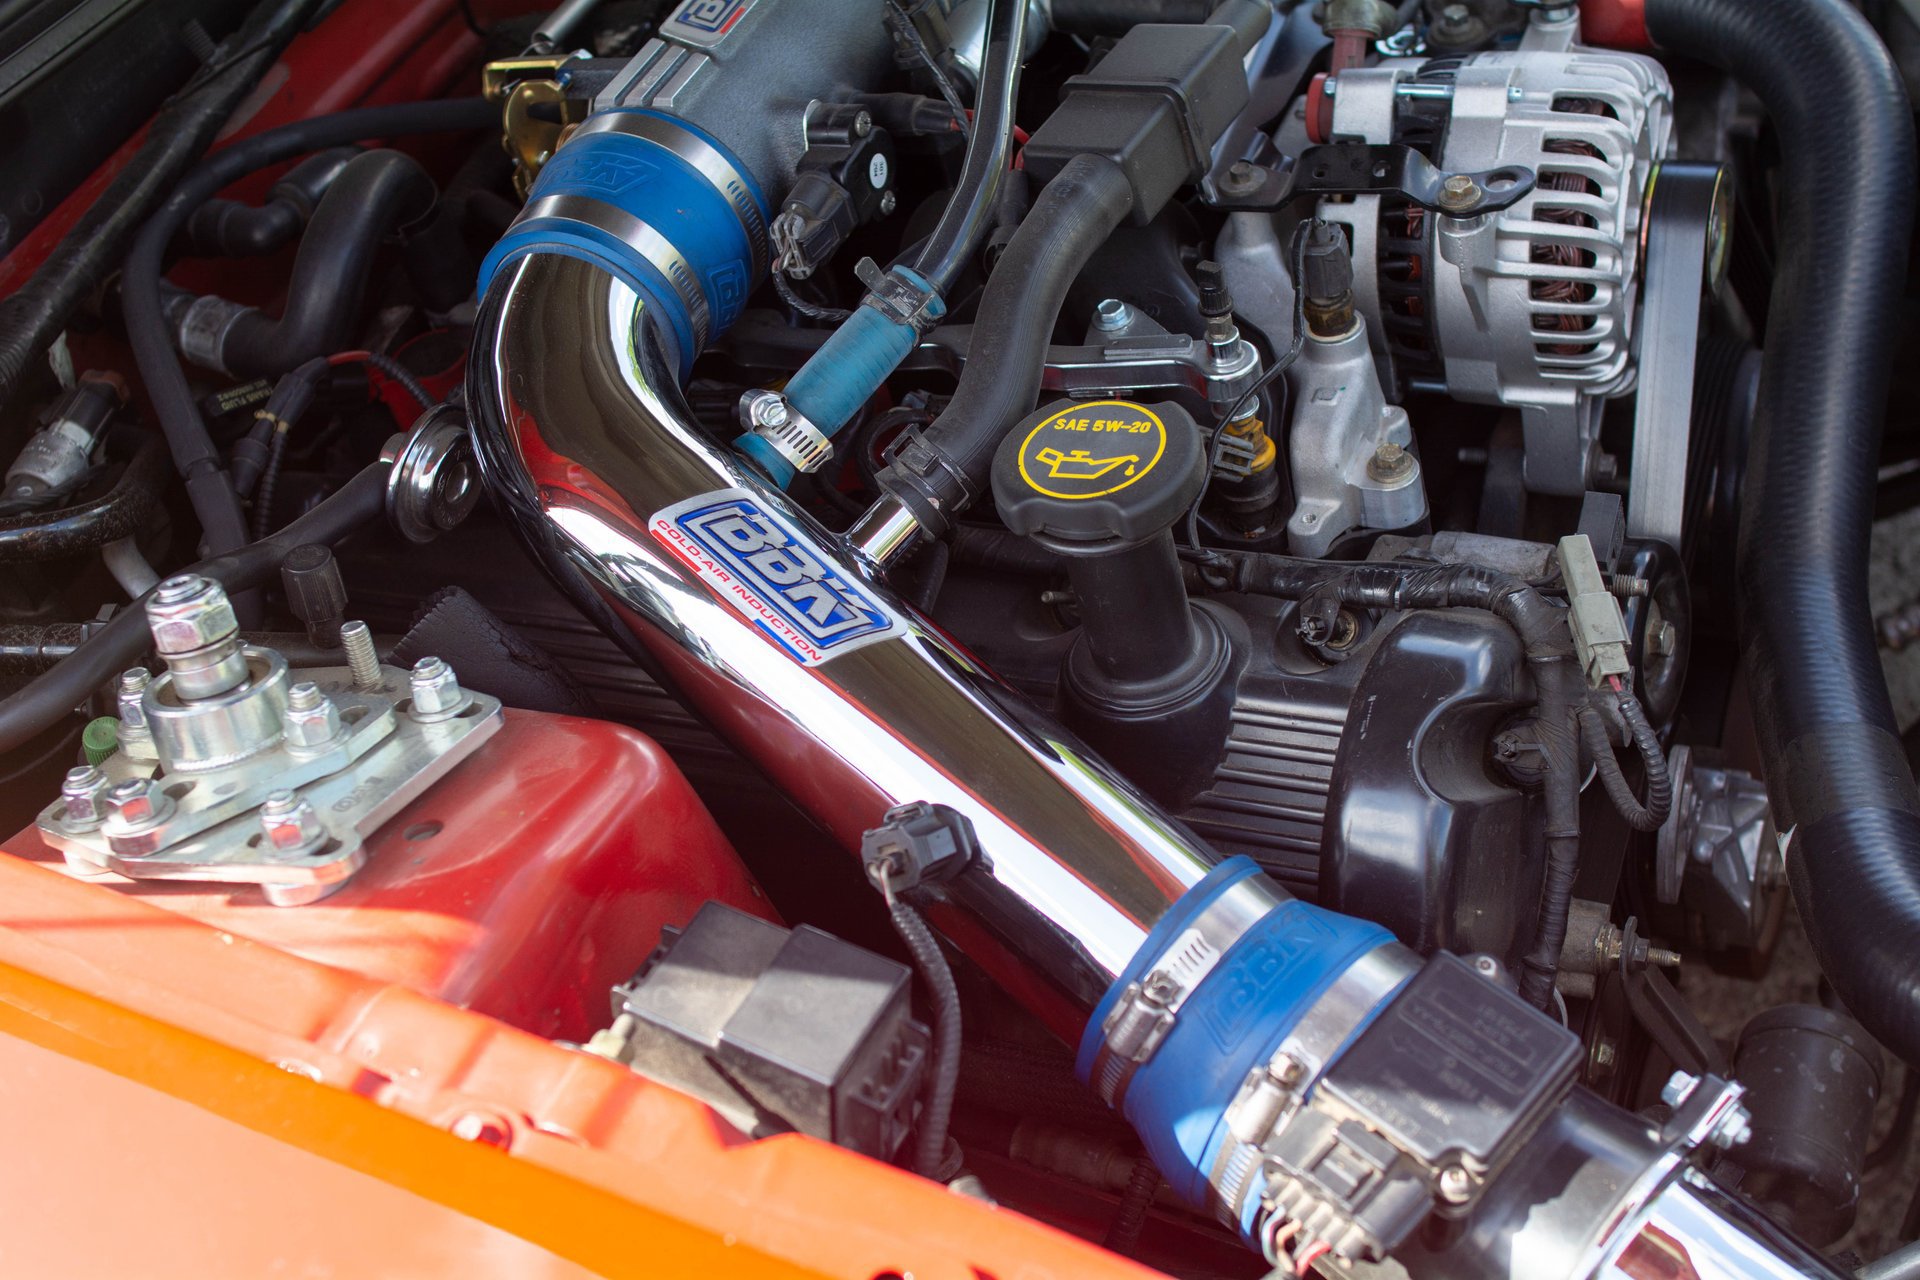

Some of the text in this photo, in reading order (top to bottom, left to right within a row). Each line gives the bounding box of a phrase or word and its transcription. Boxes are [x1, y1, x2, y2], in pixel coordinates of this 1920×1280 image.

[221, 395, 247, 411] FLUID
[1054, 418, 1151, 433] SAE 5W-20
[656, 518, 823, 662] COLD-AIR INDUCTION
[704, 512, 878, 626] BBK
[1211, 905, 1318, 1030] BBK
